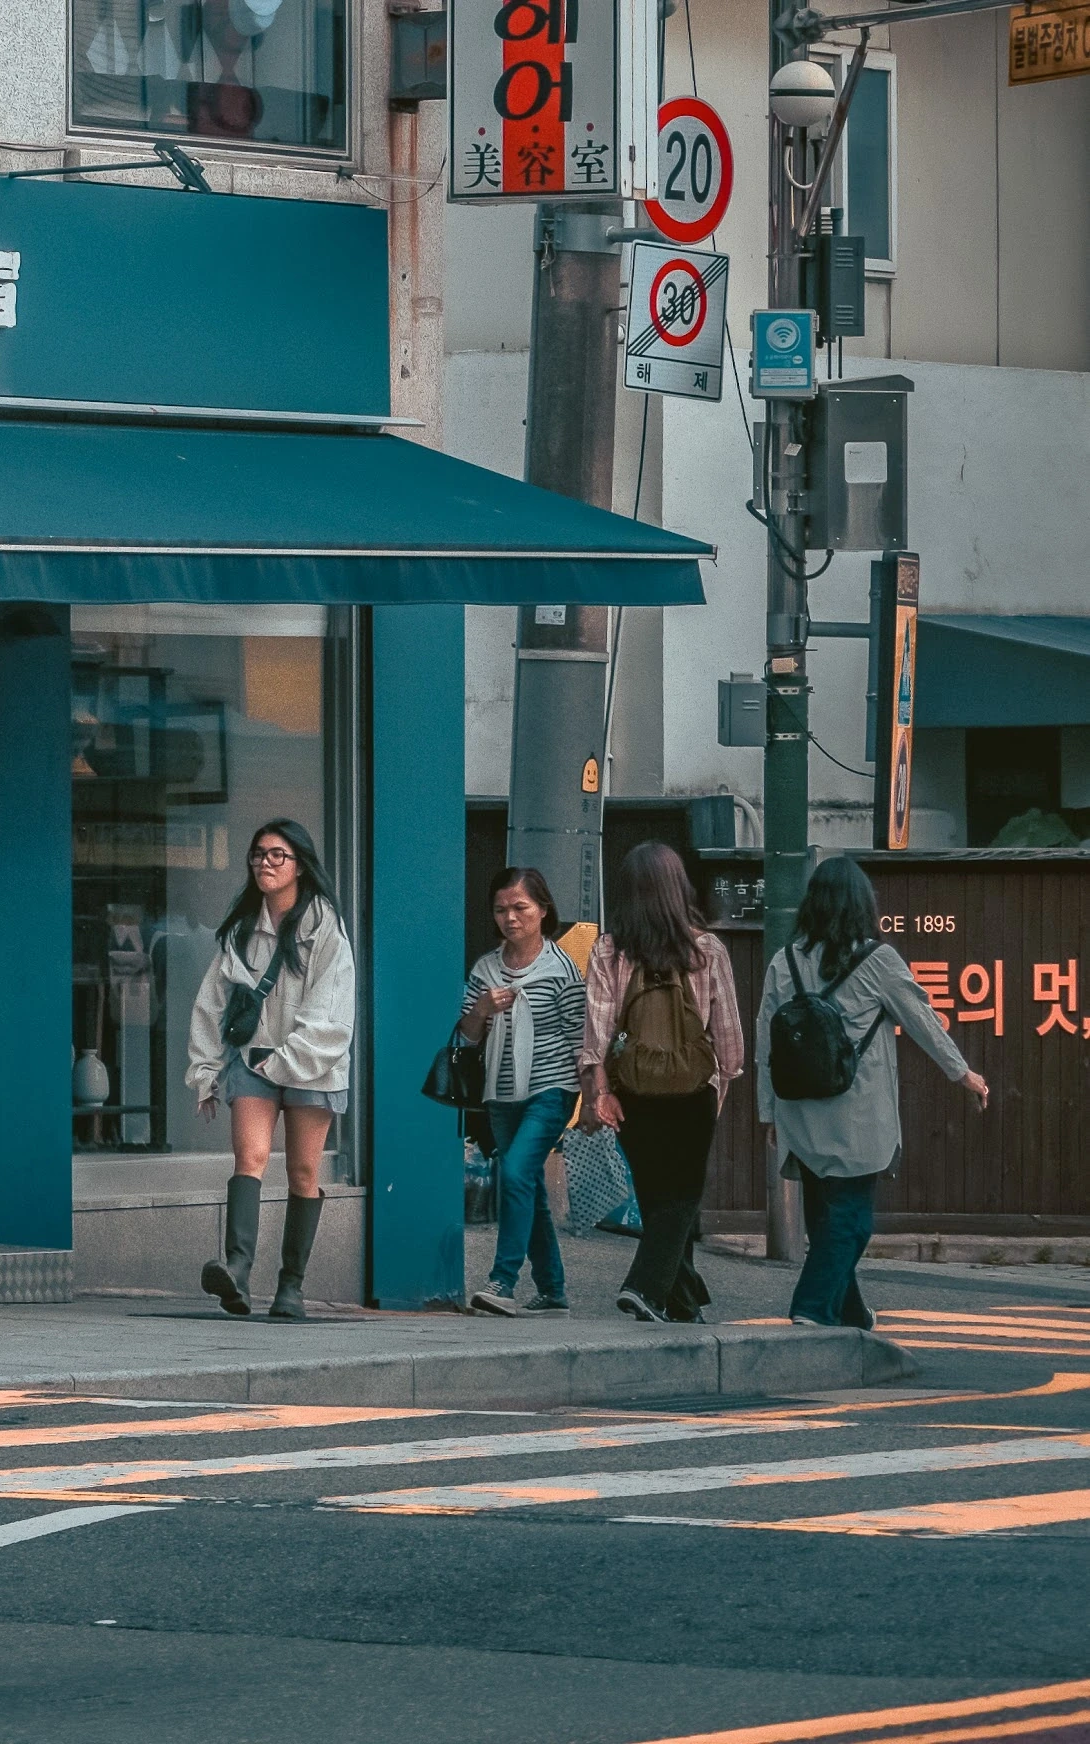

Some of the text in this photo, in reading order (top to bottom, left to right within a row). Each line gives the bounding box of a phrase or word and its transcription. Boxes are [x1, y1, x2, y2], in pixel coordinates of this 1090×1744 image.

[463, 139, 609, 189] 美容室
[664, 130, 712, 204] 20
[662, 281, 696, 326] 30
[914, 915, 956, 933] 1895
[894, 959, 1004, 1037] 통의
